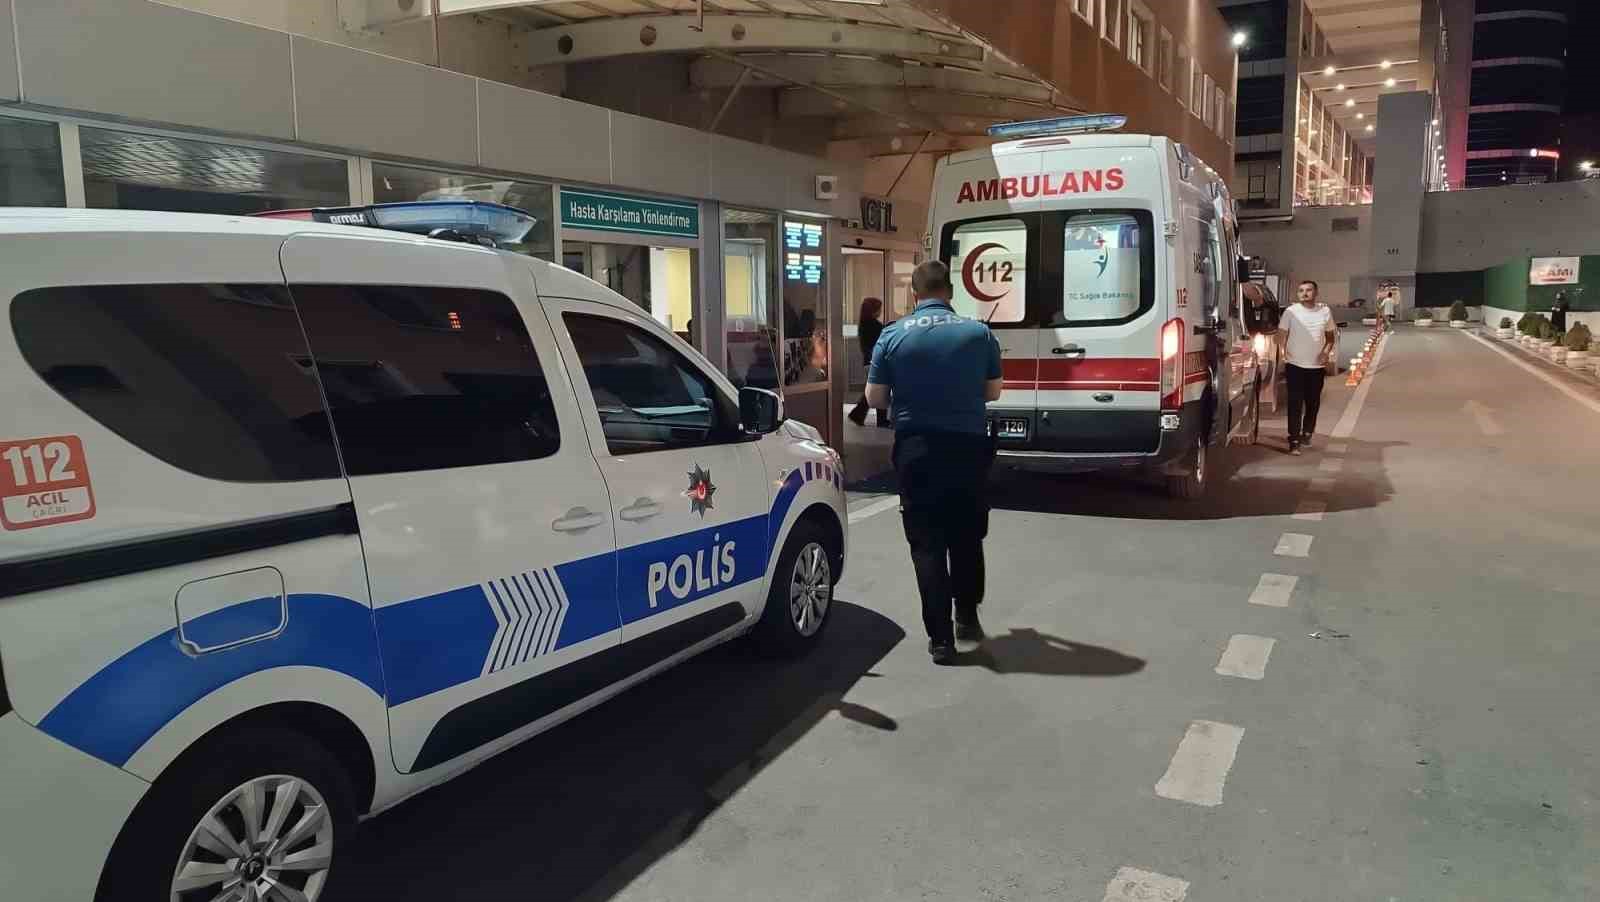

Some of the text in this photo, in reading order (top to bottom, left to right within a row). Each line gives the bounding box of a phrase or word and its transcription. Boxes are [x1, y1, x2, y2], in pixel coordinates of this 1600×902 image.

[957, 168, 1123, 203] AMBULANS
[570, 201, 690, 228] Hasta Karşılama Yönlendirme
[976, 261, 1013, 283] 112
[1005, 421, 1024, 433] 120
[3, 442, 76, 486] 112
[647, 532, 736, 608] POLİS
